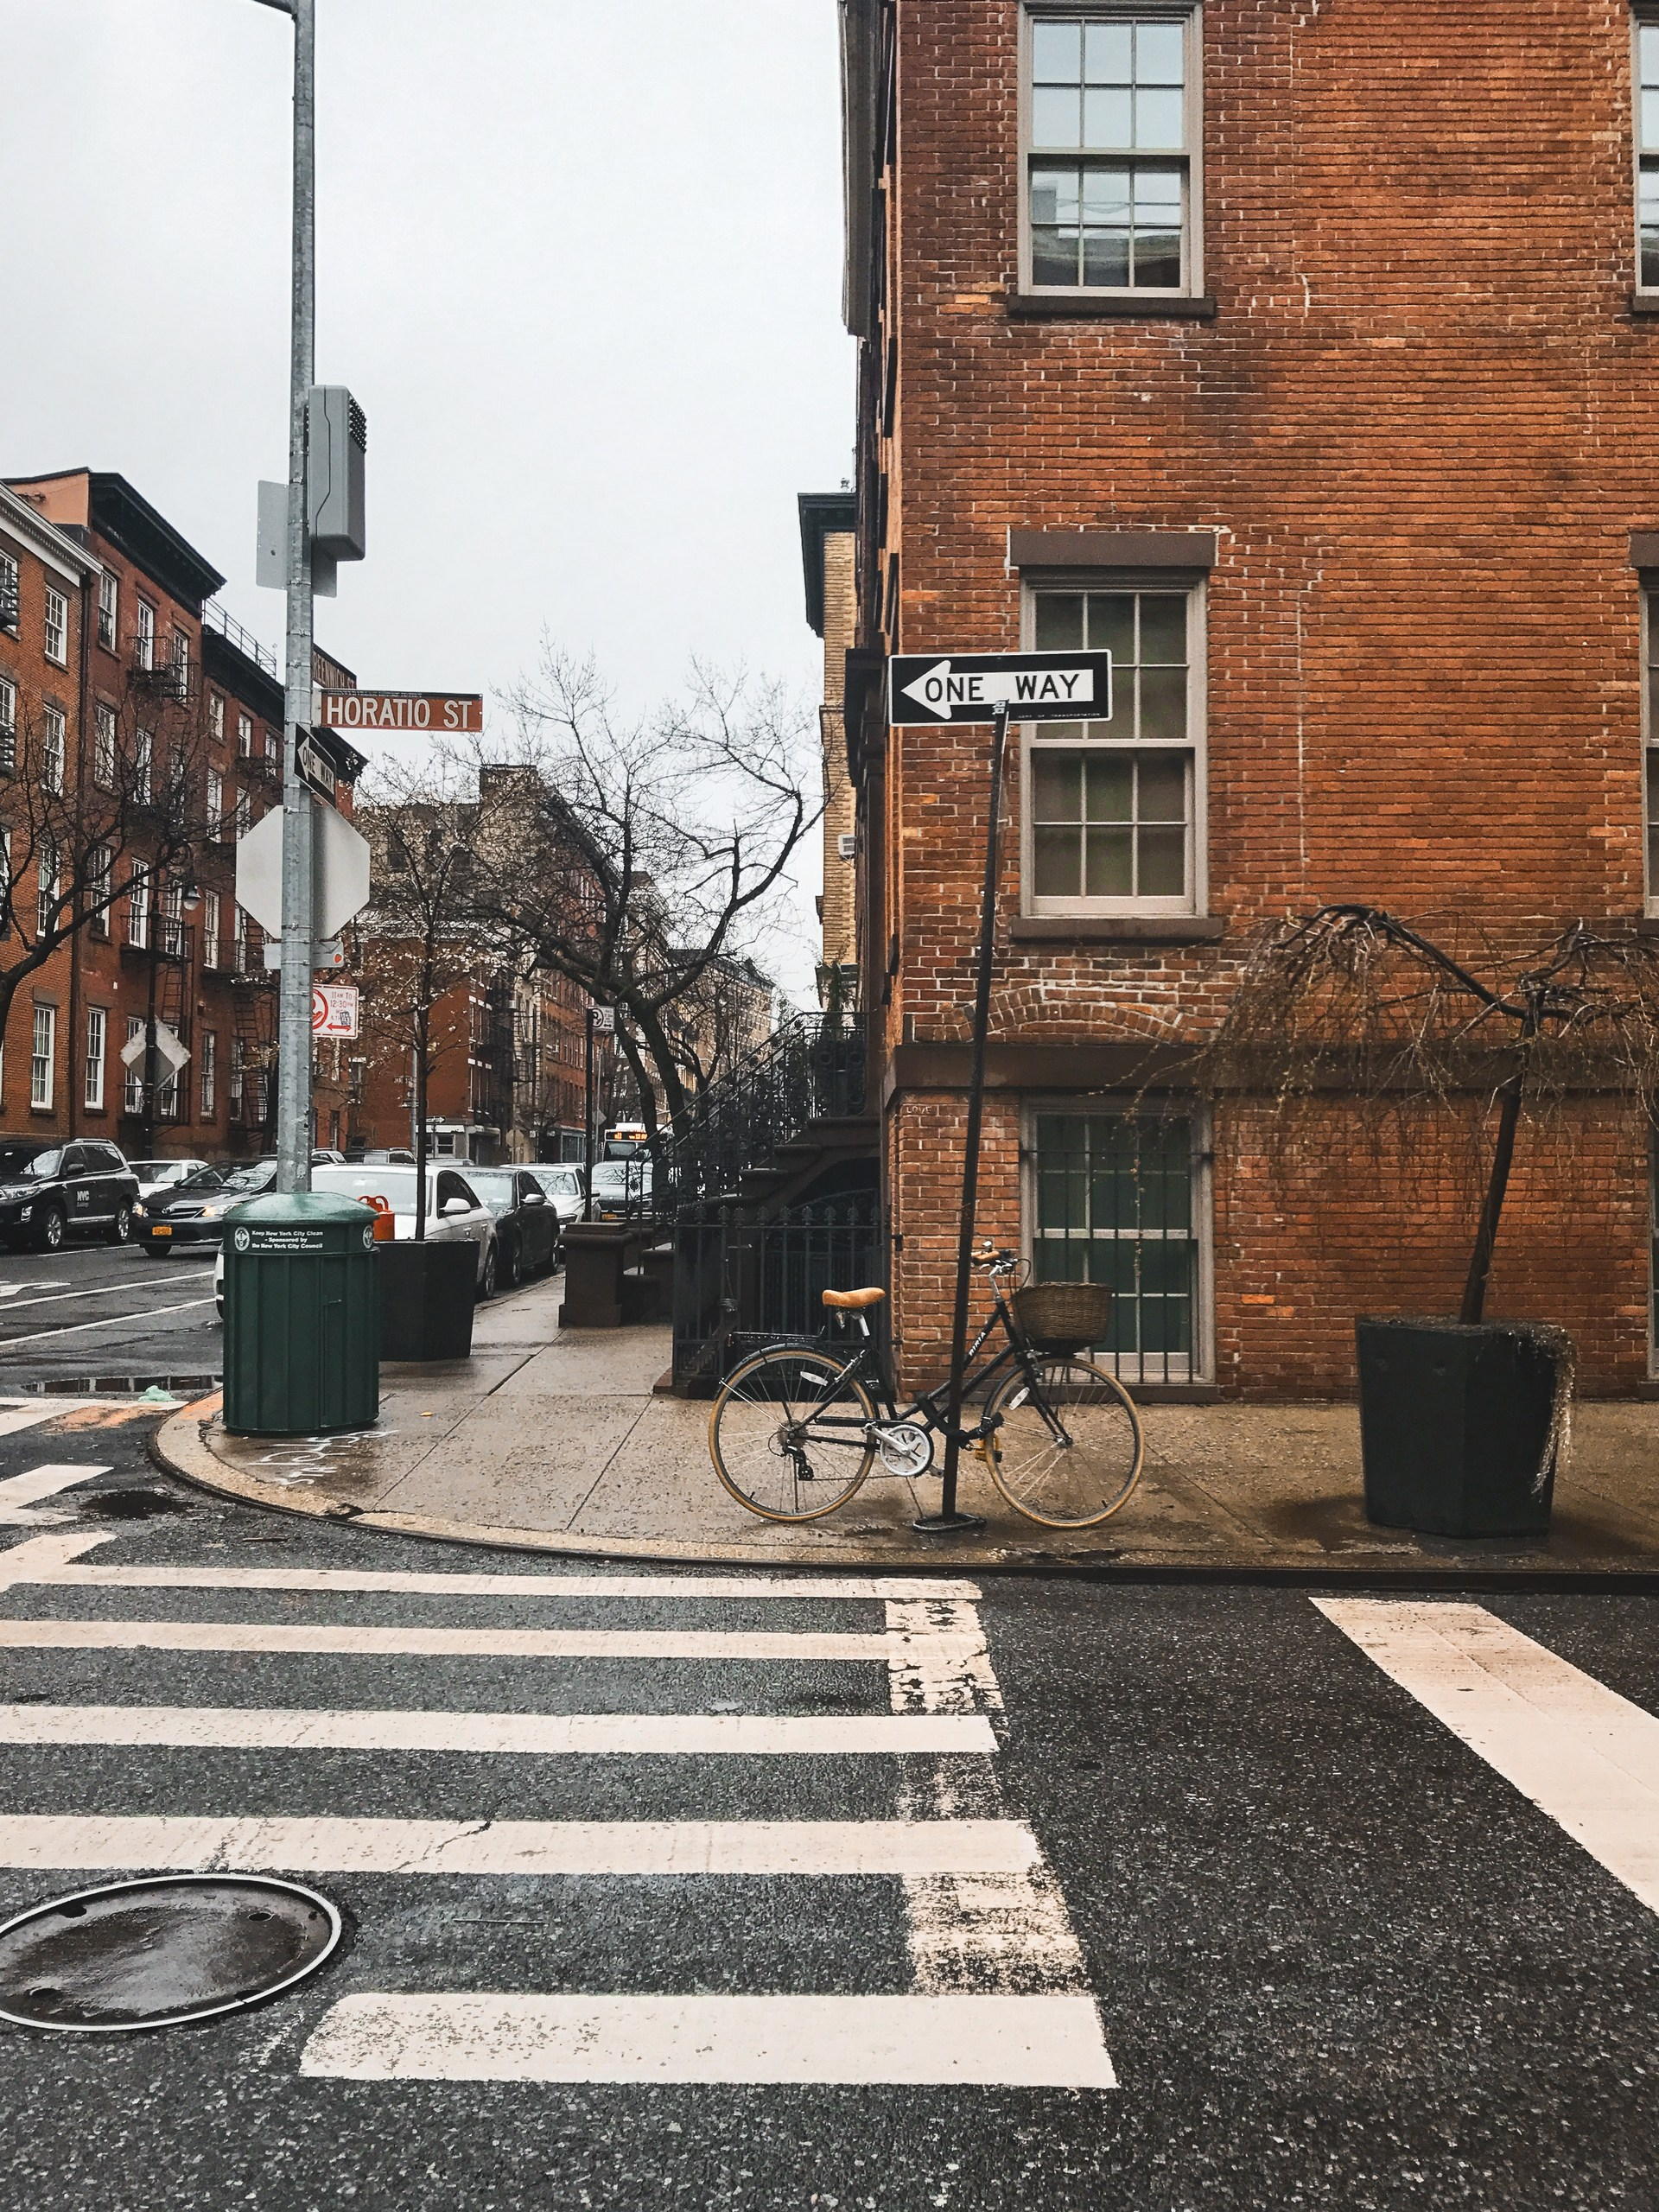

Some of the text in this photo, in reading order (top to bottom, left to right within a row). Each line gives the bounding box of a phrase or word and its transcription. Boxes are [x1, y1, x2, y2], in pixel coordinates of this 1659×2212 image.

[312, 651, 346, 689] REENWICH
[925, 673, 1080, 702] ONE WAY
[327, 696, 473, 728] HORATIO ST
[302, 747, 334, 790] ONE WAY
[906, 1105, 932, 1115] LOVE
